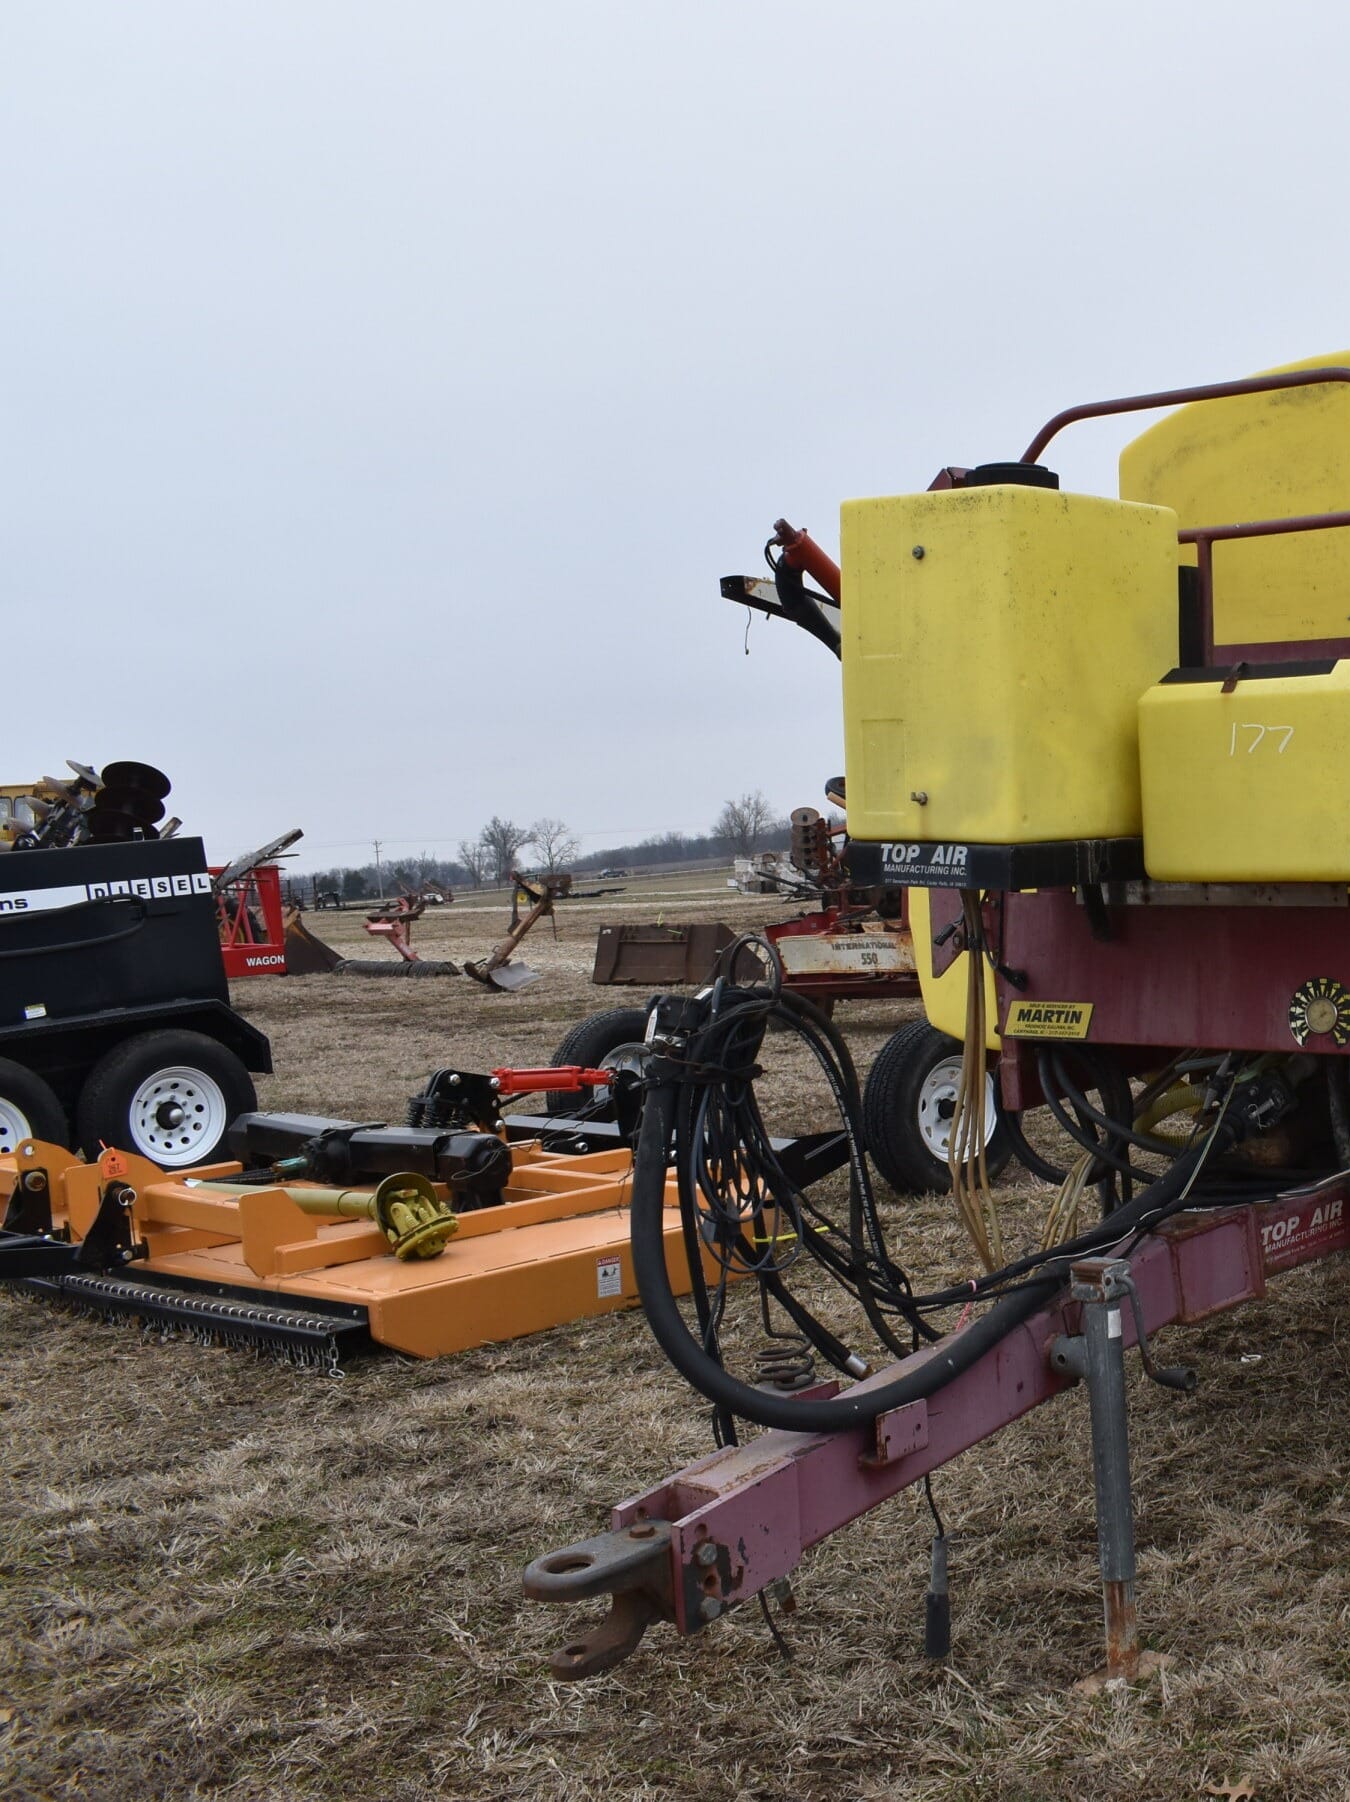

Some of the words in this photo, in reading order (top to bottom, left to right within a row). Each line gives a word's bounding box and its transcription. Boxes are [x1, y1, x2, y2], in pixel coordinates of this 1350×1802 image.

[1229, 721, 1295, 757] 177
[881, 843, 920, 863] TOP
[930, 845, 968, 865] AIR
[883, 863, 949, 875] MANUFACTURING
[950, 866, 967, 876] INC.
[94, 877, 208, 899] DIESEL
[831, 941, 897, 951] INTERNATIONAL
[246, 955, 285, 967] WAGON
[860, 952, 878, 965] 550
[1017, 1008, 1083, 1024] MARTIN
[1260, 1216, 1300, 1246] TOP
[1310, 1200, 1343, 1228] AIR
[1264, 1224, 1329, 1254] MANUFACTURING
